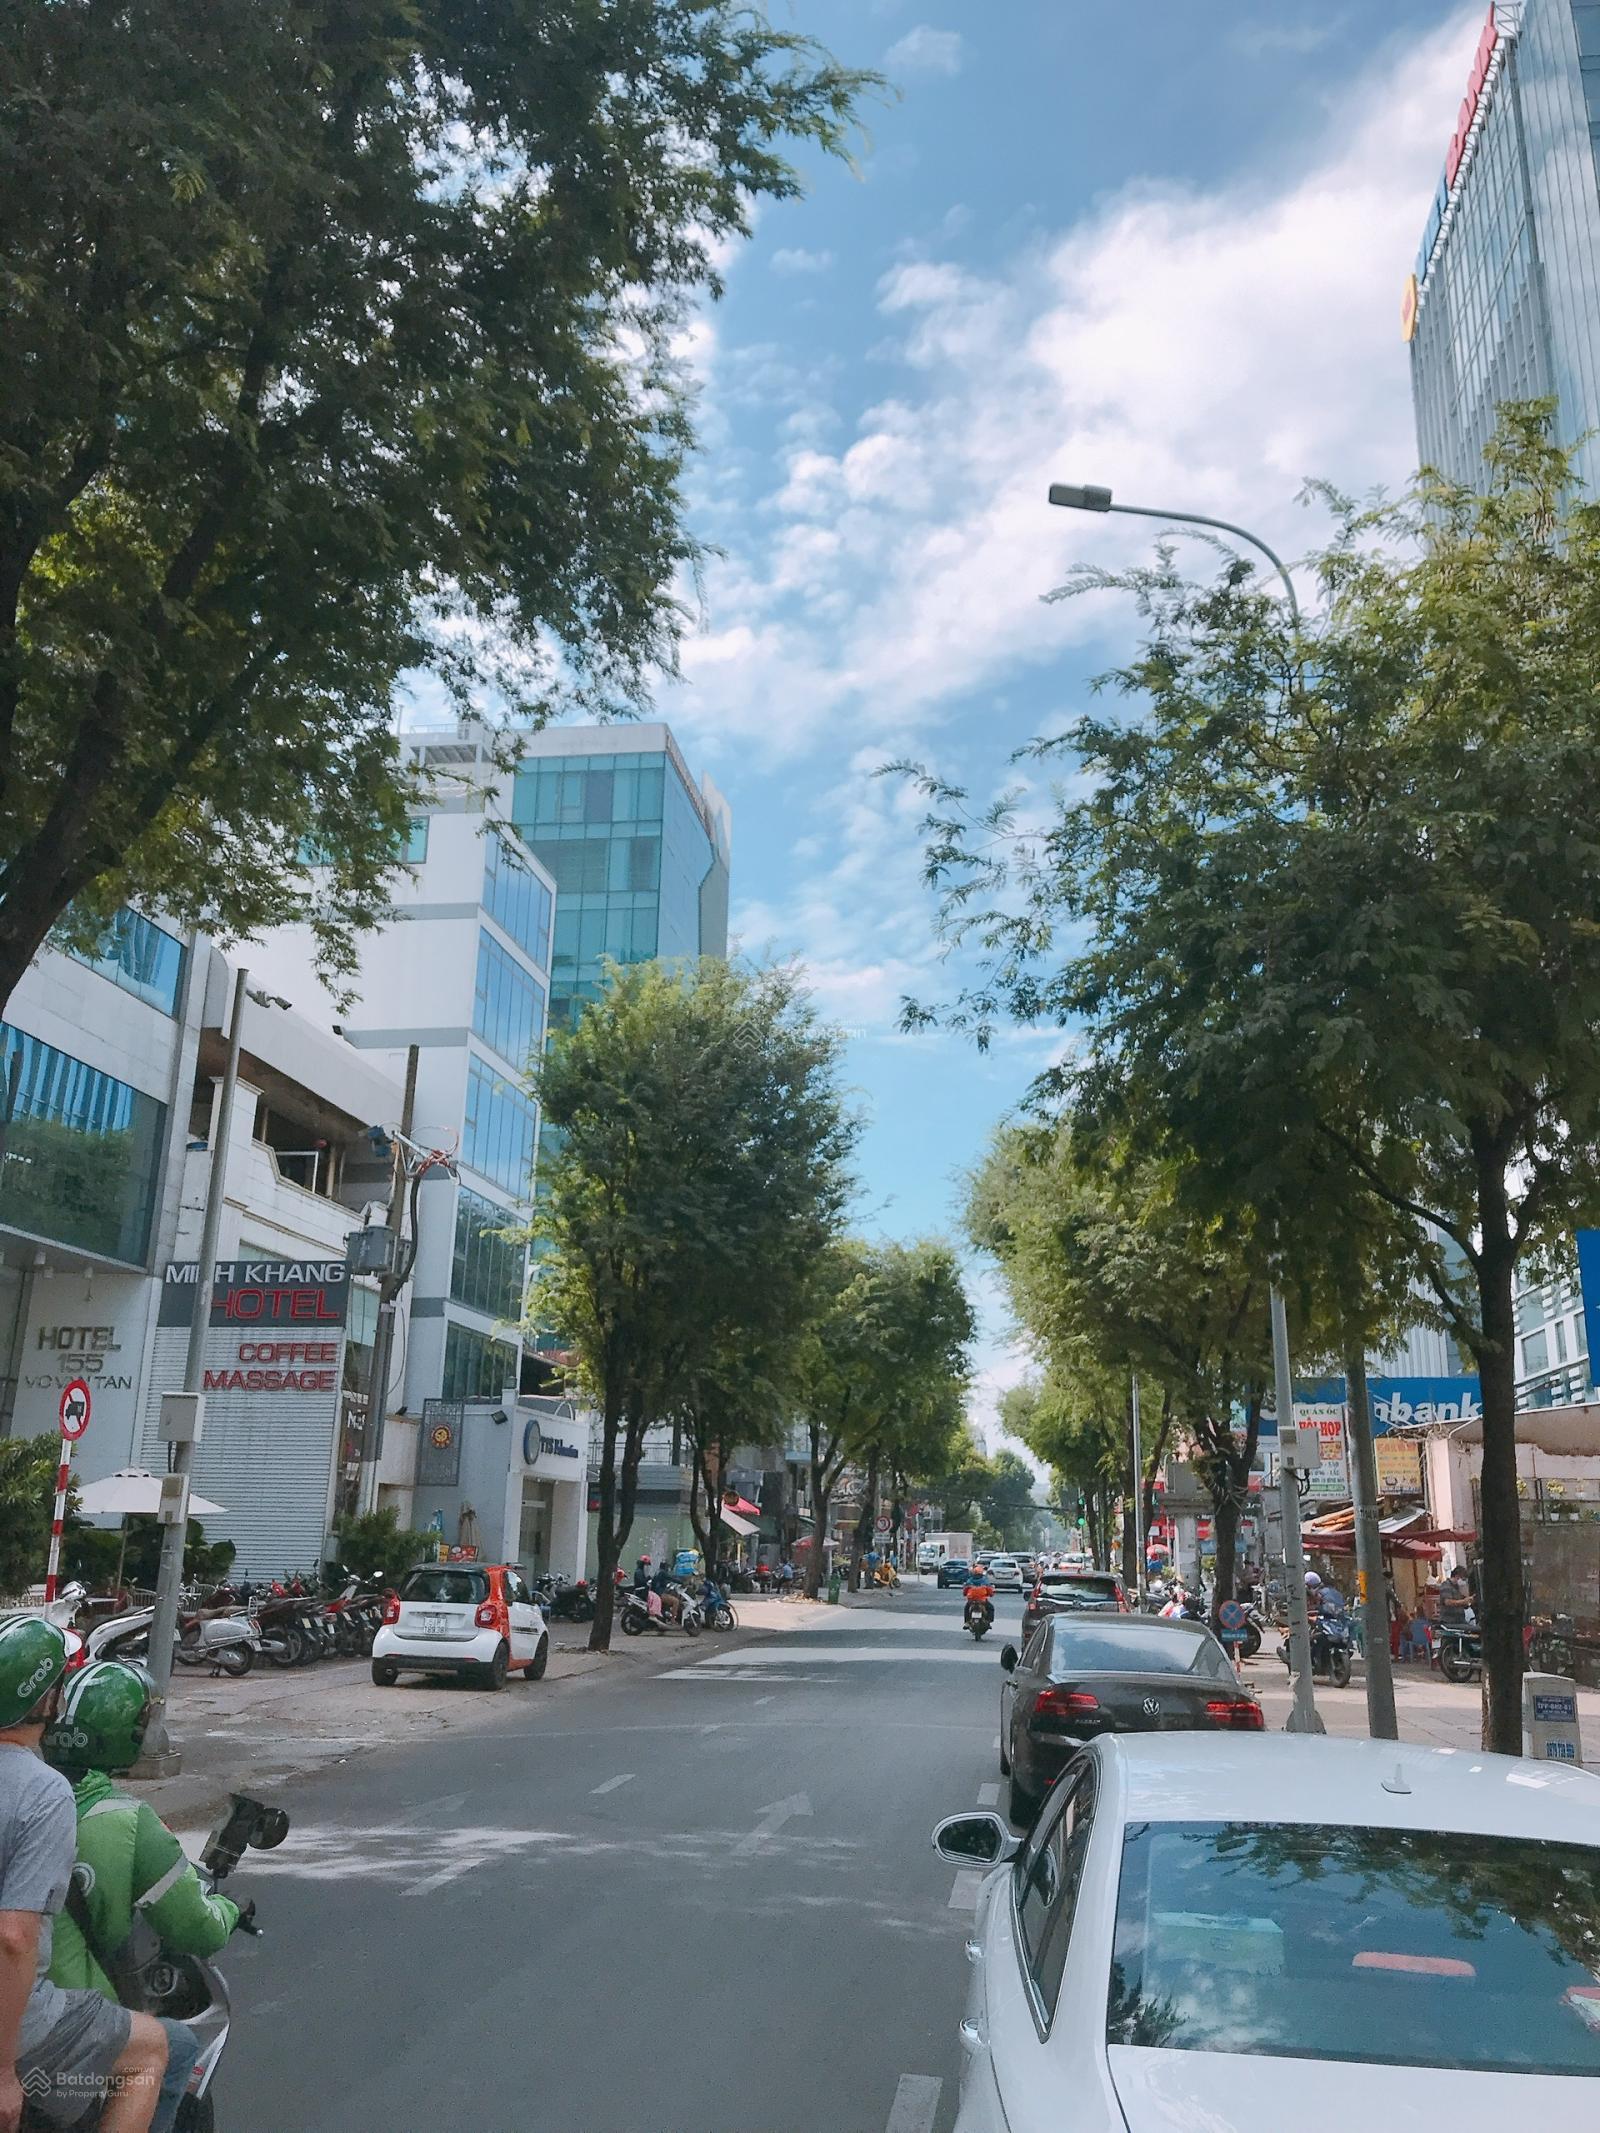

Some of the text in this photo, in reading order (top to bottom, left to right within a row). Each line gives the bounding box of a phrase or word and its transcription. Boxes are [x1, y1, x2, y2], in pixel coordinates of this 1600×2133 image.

[165, 1263, 346, 1284] MIH KHANG
[211, 1288, 340, 1319] HOTEL
[37, 1326, 121, 1351] HOTEL
[57, 1353, 105, 1373] 155
[239, 1343, 337, 1364] COFFEE
[203, 1369, 338, 1392] MASSAGE
[17, 1658, 54, 1698] Grab
